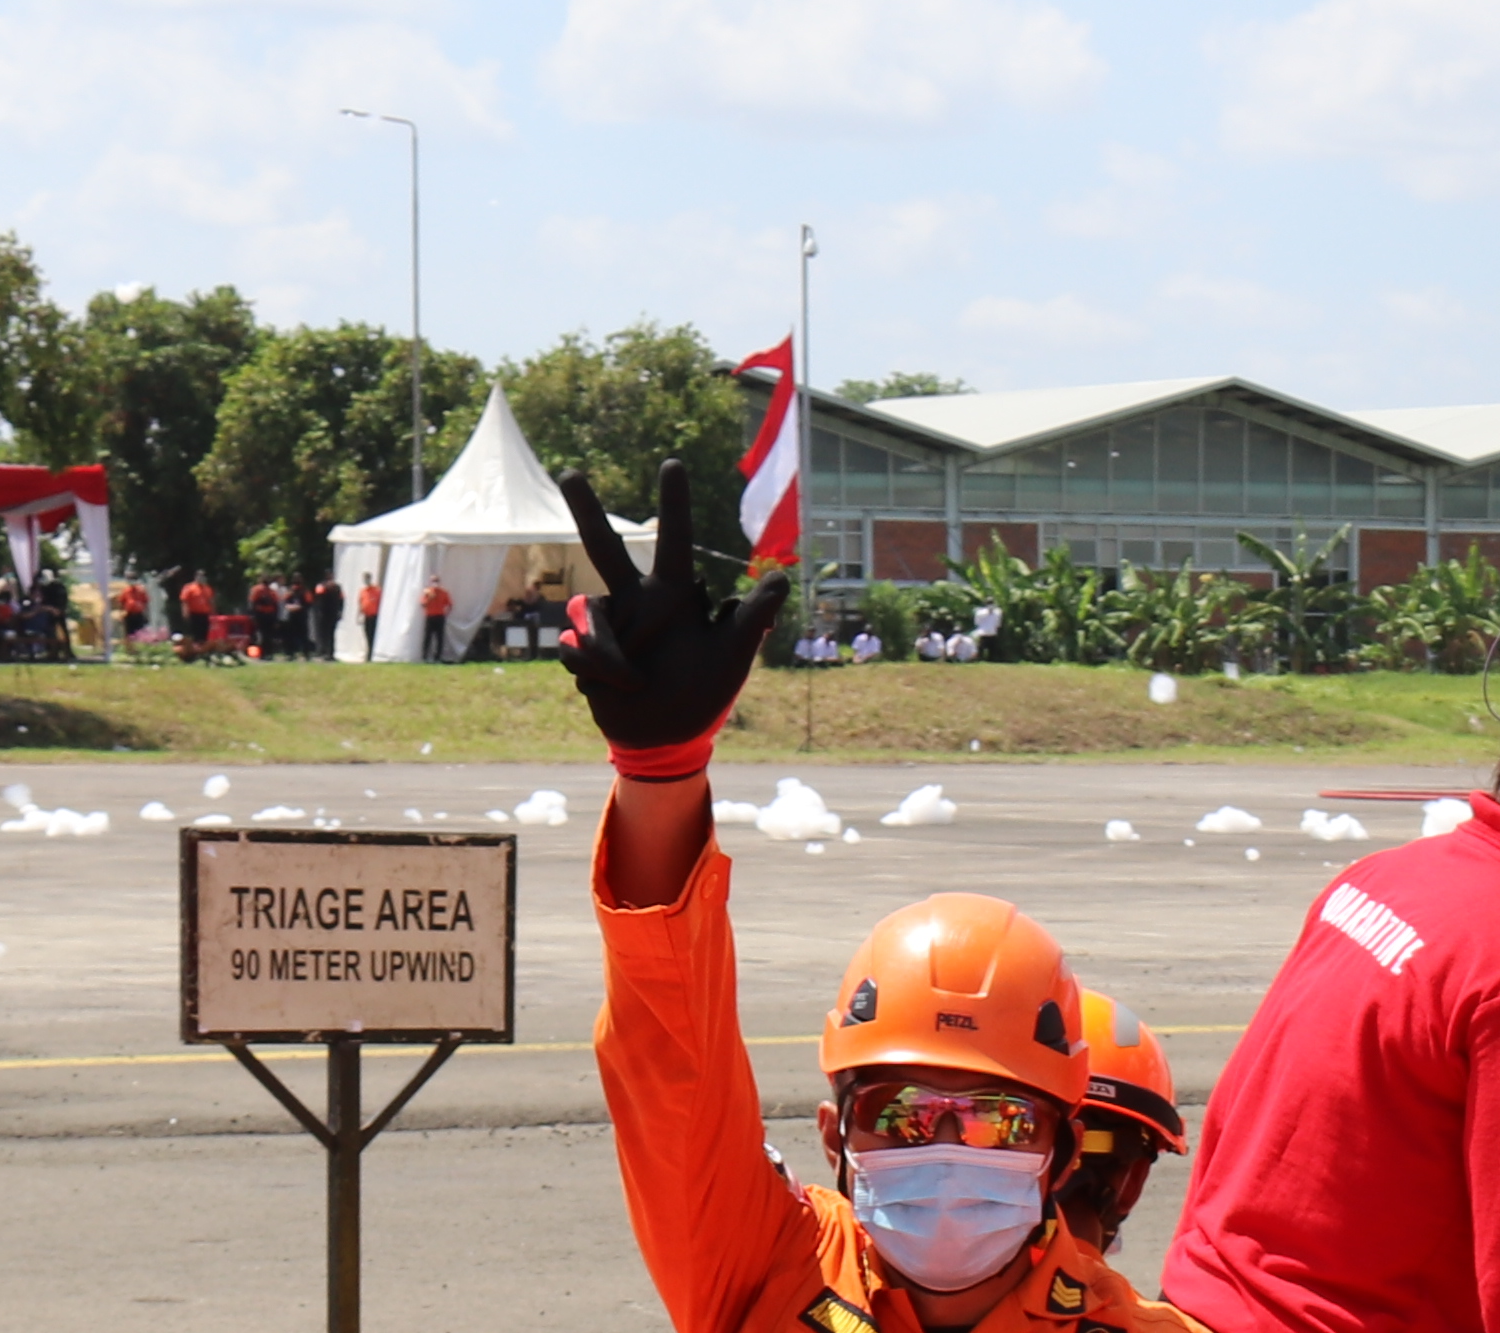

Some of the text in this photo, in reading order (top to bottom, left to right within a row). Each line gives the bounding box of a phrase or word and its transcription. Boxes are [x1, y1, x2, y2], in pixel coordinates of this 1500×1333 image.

[230, 886, 475, 931] TRIAGE AREA
[1320, 882, 1425, 975] QUARANTINE
[231, 948, 475, 982] 90 METER UPWIND
[936, 1013, 979, 1032] PETZL
